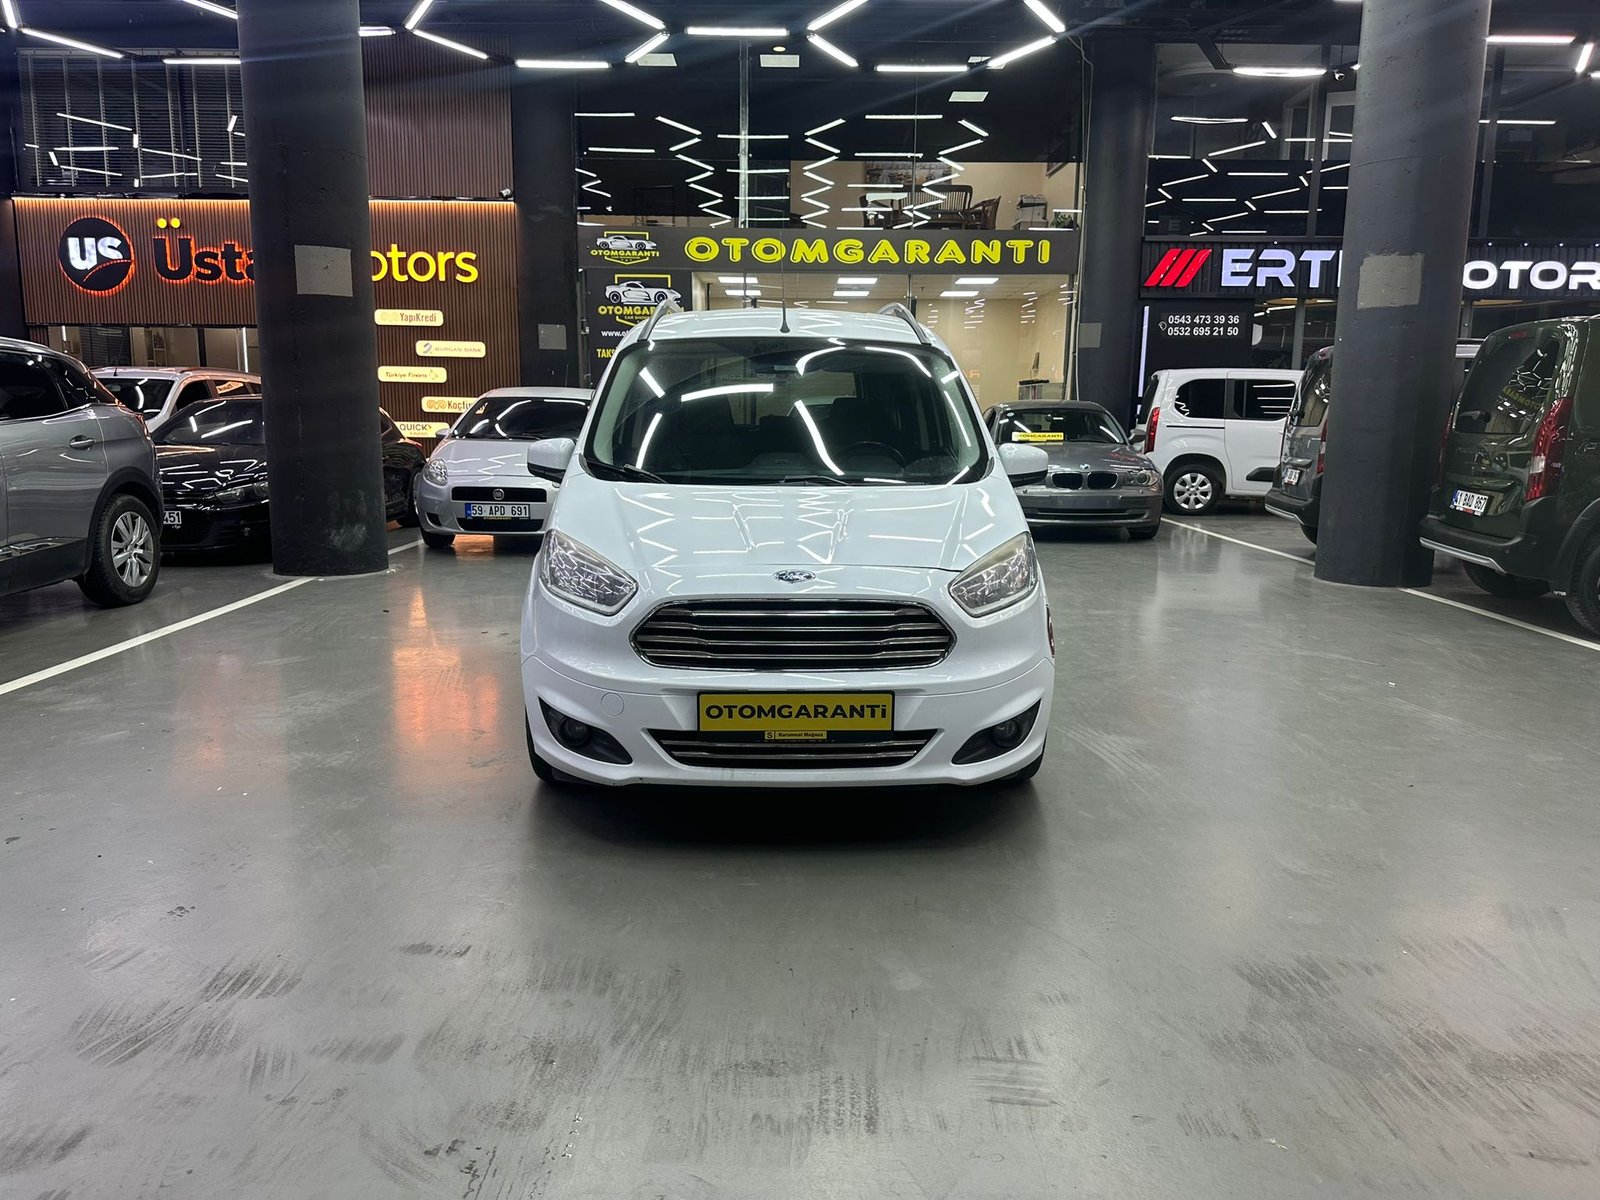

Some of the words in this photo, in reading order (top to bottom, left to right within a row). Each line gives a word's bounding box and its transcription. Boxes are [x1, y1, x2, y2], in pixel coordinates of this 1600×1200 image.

[684, 236, 1051, 264] OTOMGARANTI
[1168, 315, 1191, 324] 0543
[1193, 315, 1211, 324] 473
[1213, 315, 1225, 324] 39
[1227, 315, 1239, 324] 36
[1167, 327, 1190, 335] 0532
[1193, 327, 1210, 335] 695
[1213, 327, 1223, 335] 21
[1227, 327, 1238, 335] 50
[399, 423, 427, 431] QUICK
[472, 505, 483, 515] 59
[489, 505, 506, 516] APD
[511, 506, 528, 516] 691
